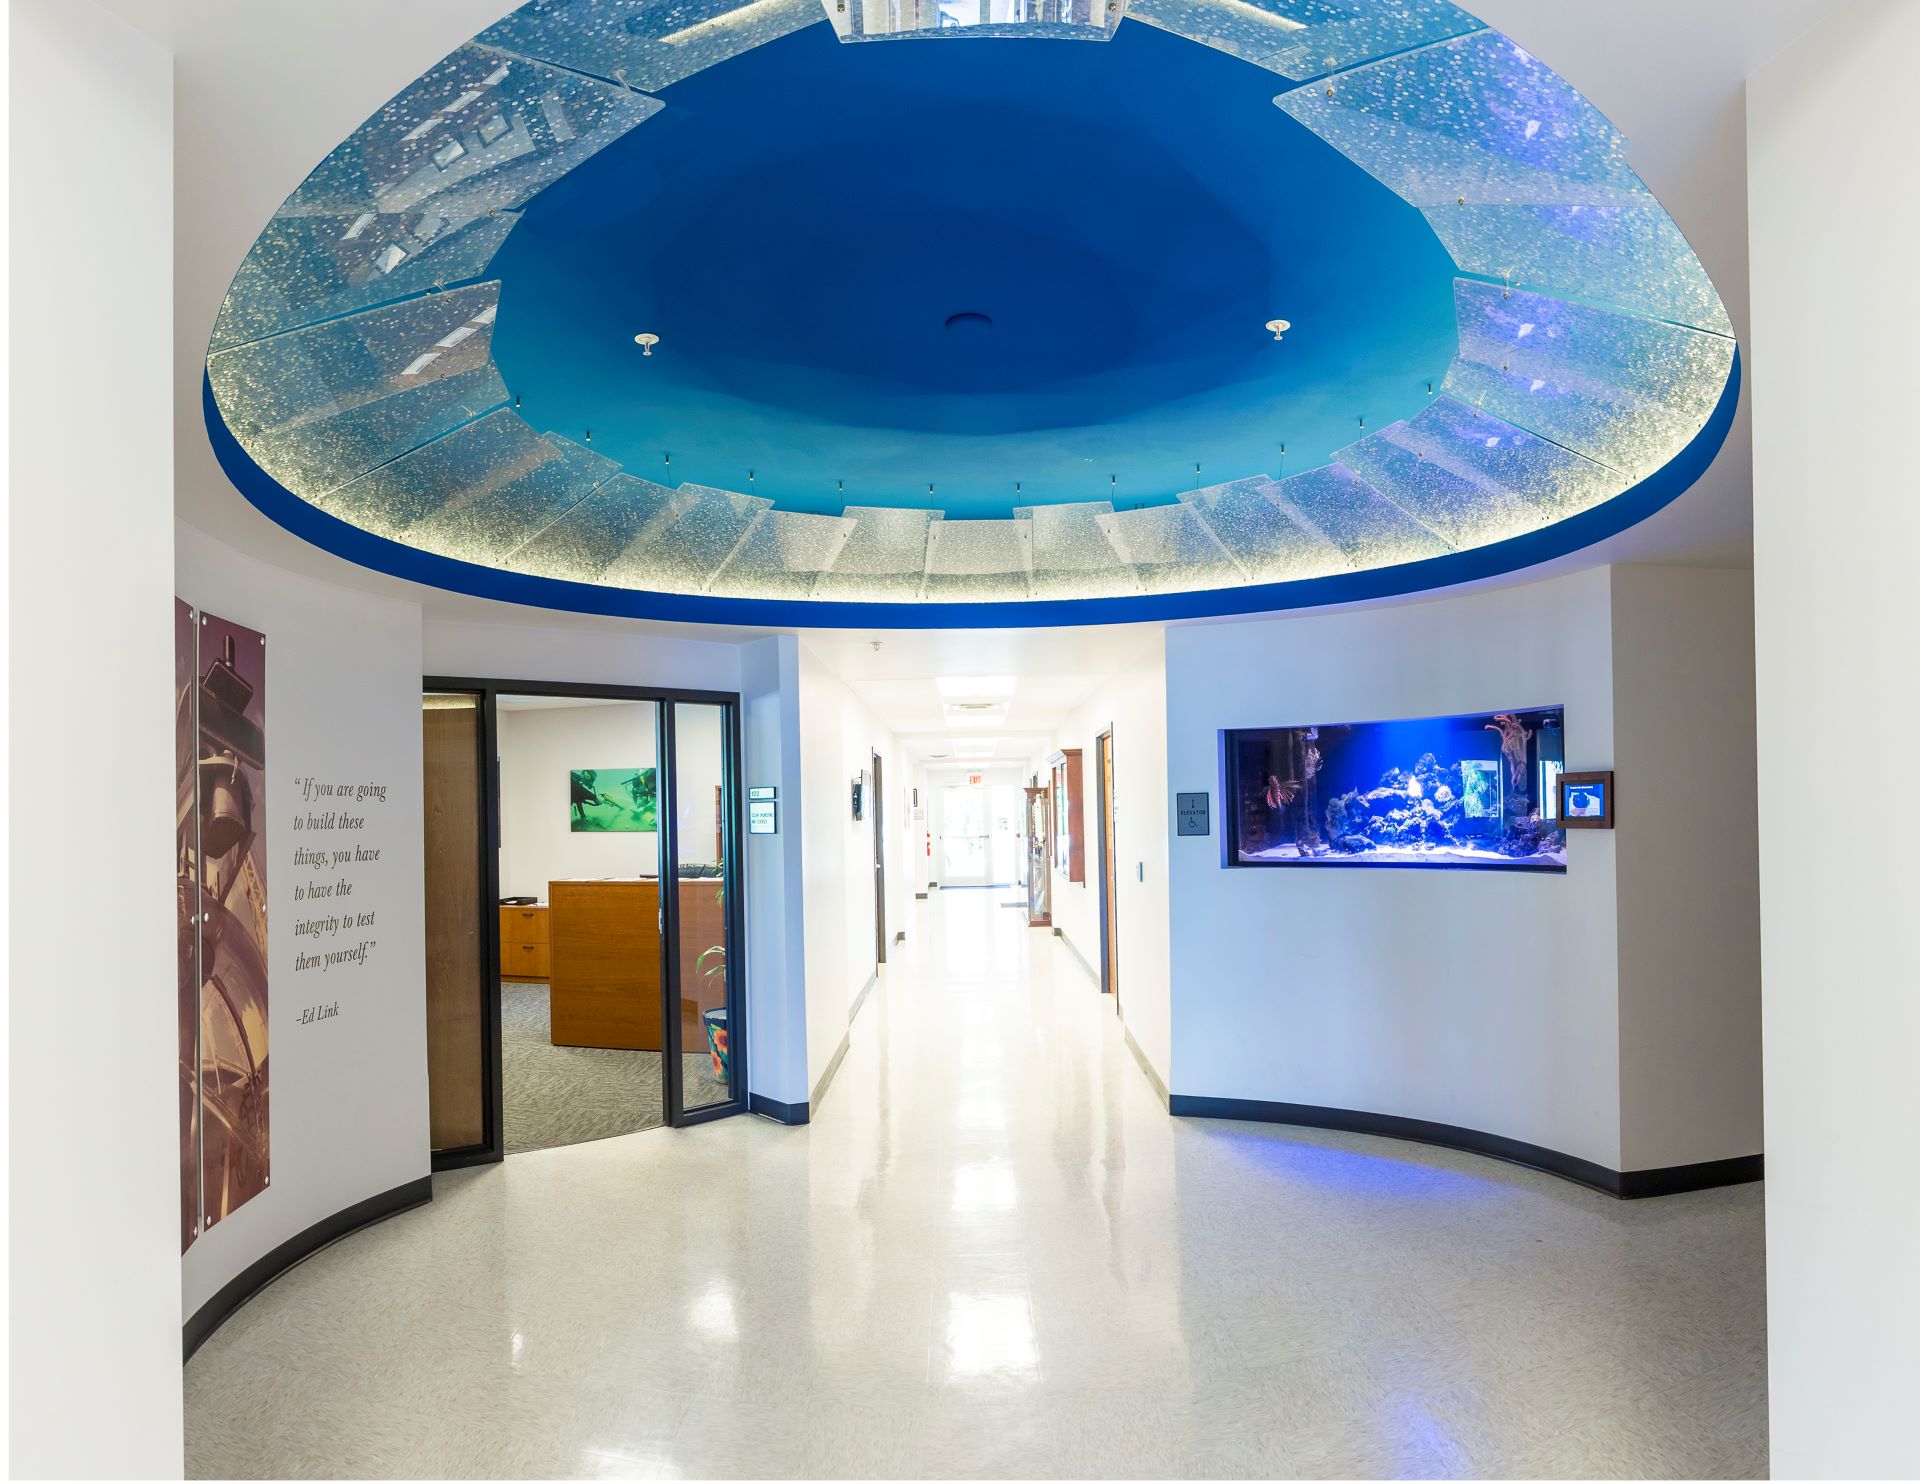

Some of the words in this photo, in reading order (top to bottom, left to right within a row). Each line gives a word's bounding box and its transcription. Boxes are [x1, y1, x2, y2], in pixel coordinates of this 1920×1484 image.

[969, 775, 982, 784] EXIT
[313, 783, 334, 802] you
[336, 784, 355, 797] are
[356, 781, 387, 803] going
[293, 815, 304, 831] to
[306, 812, 336, 830] build
[338, 812, 365, 830] these
[294, 847, 329, 870] things,
[331, 850, 352, 870] you
[354, 844, 380, 862] have
[294, 884, 305, 901] to
[307, 881, 333, 899] have
[335, 878, 353, 896] the
[294, 914, 339, 939] integrity
[342, 913, 354, 929] to
[356, 911, 375, 927] test
[295, 951, 321, 972] them
[317, 1001, 340, 1021] Link
